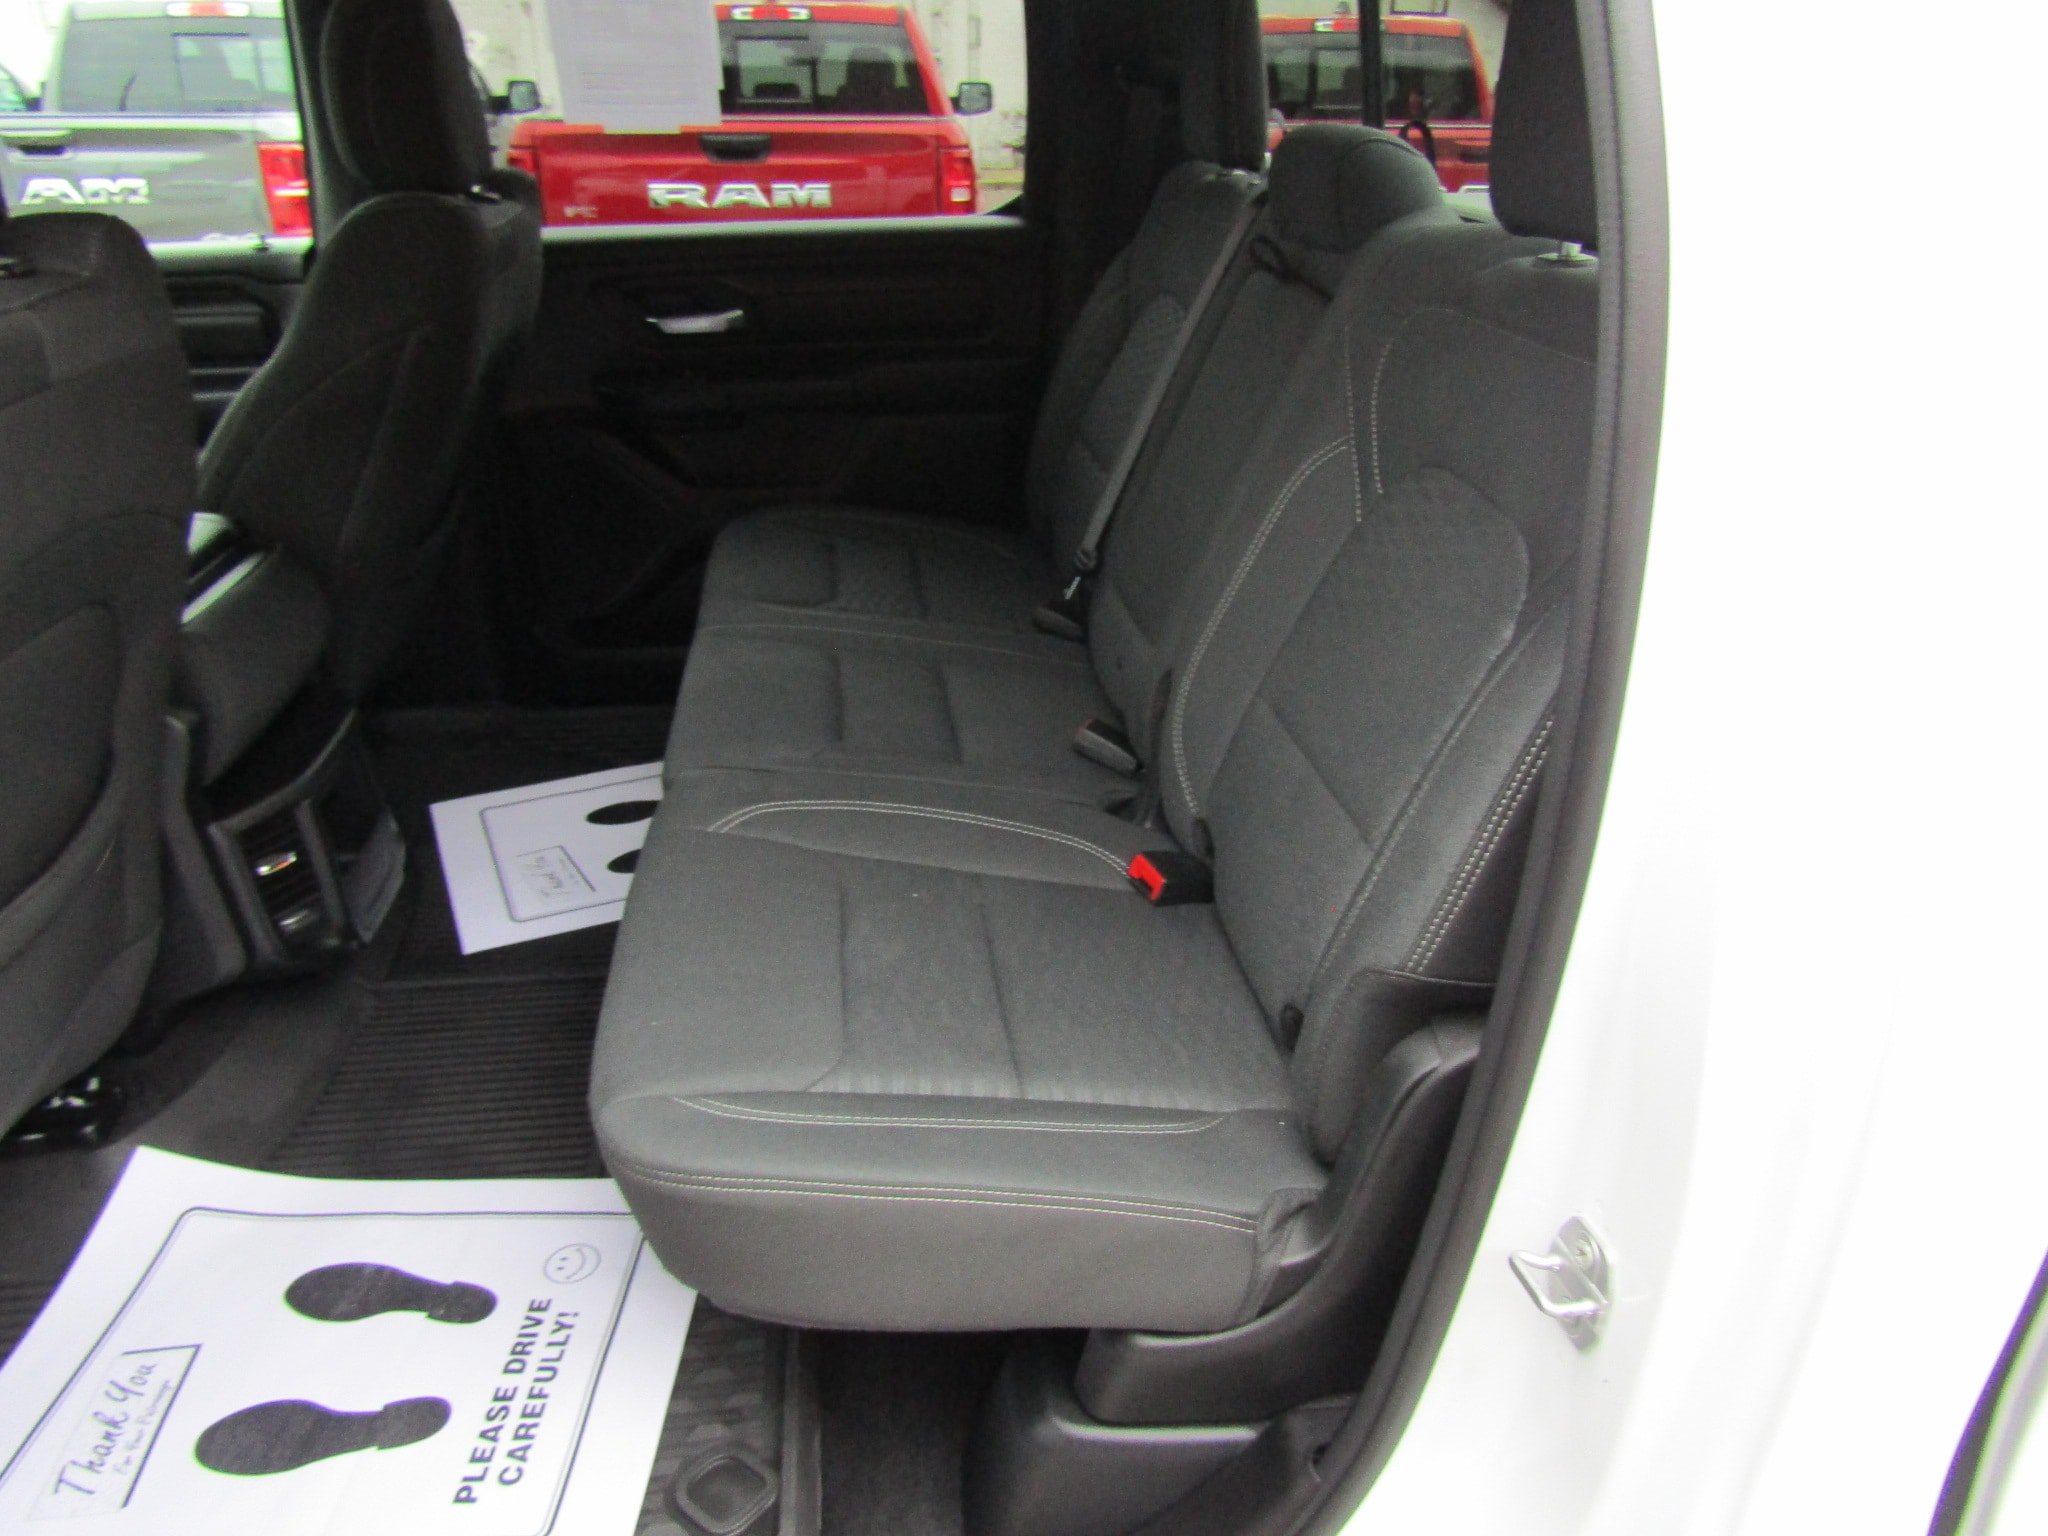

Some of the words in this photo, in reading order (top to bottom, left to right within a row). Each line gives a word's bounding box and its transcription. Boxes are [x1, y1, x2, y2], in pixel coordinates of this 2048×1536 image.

[20, 177, 150, 205] AM
[647, 180, 832, 209] RAM
[54, 1410, 129, 1495] Thank
[104, 1363, 158, 1402] You
[452, 1386, 518, 1504] PLEASE
[502, 1298, 552, 1375] DRIVE
[498, 1311, 580, 1486] CAREFULLY!
